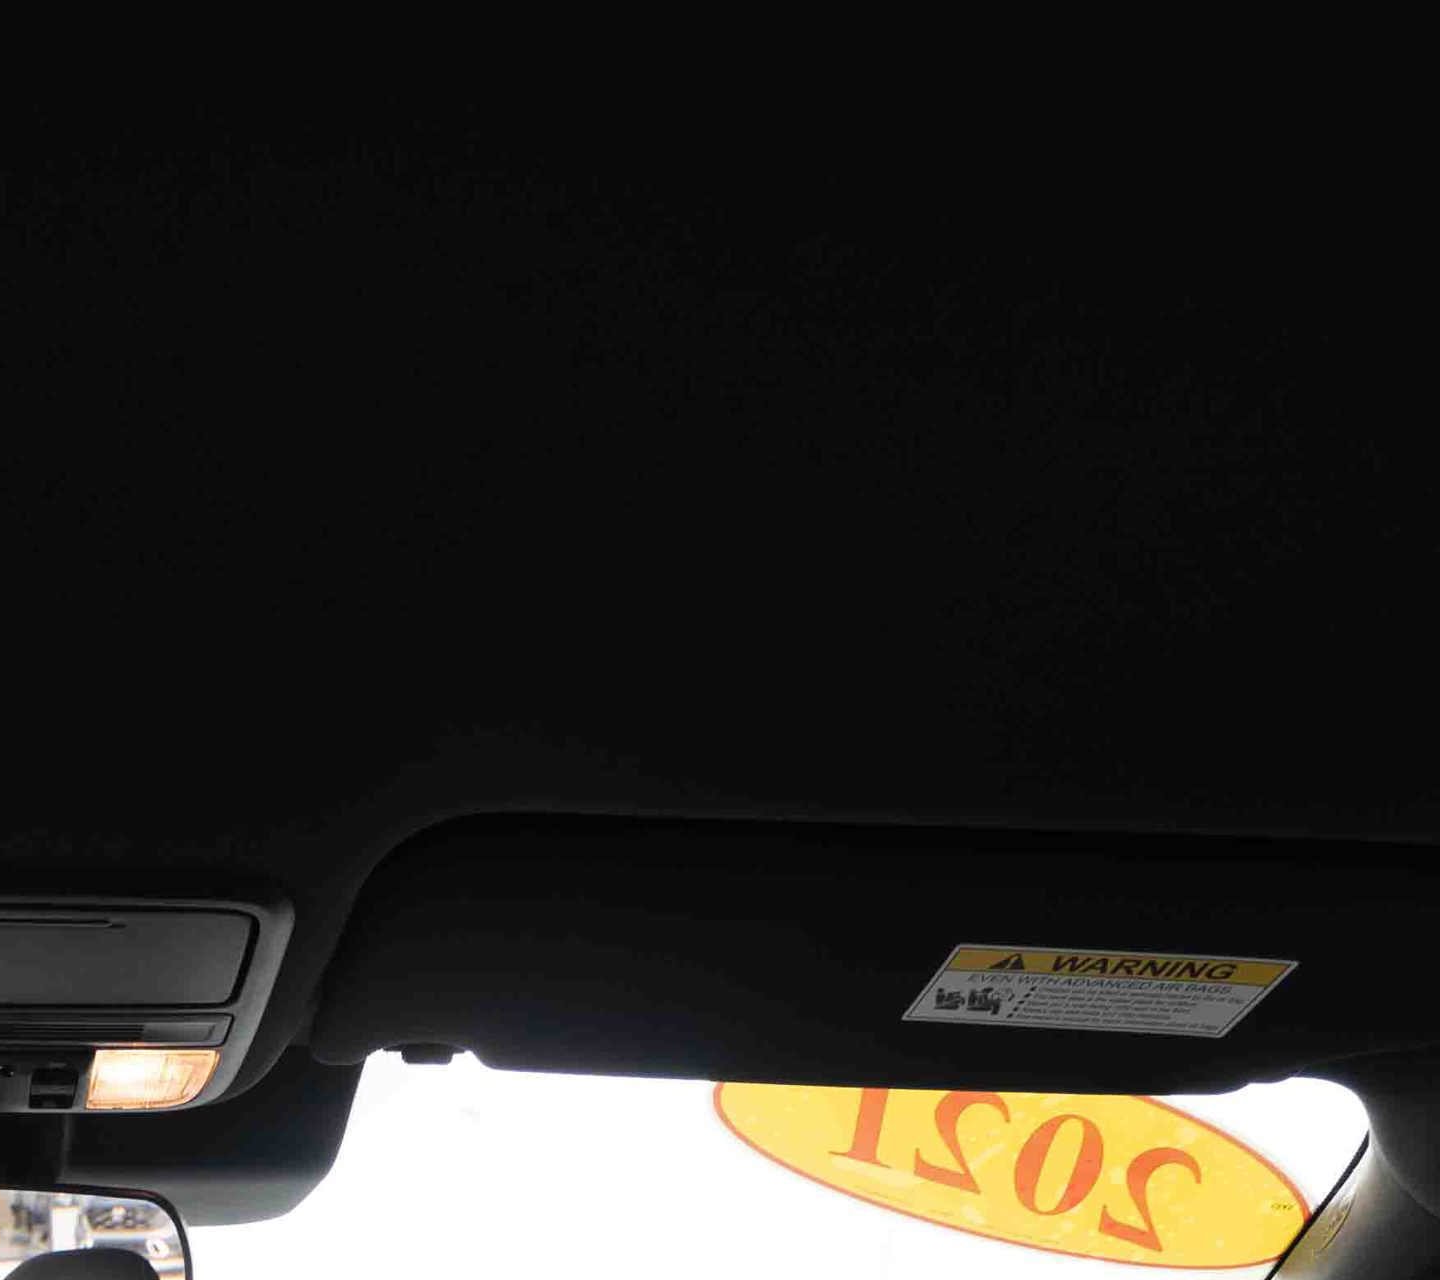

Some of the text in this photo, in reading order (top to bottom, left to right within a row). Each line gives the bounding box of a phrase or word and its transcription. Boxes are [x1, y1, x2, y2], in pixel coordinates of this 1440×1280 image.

[1050, 955, 1238, 980] WARNING
[966, 974, 1233, 994] EVEN WITH ADVANCED AIR BAGS
